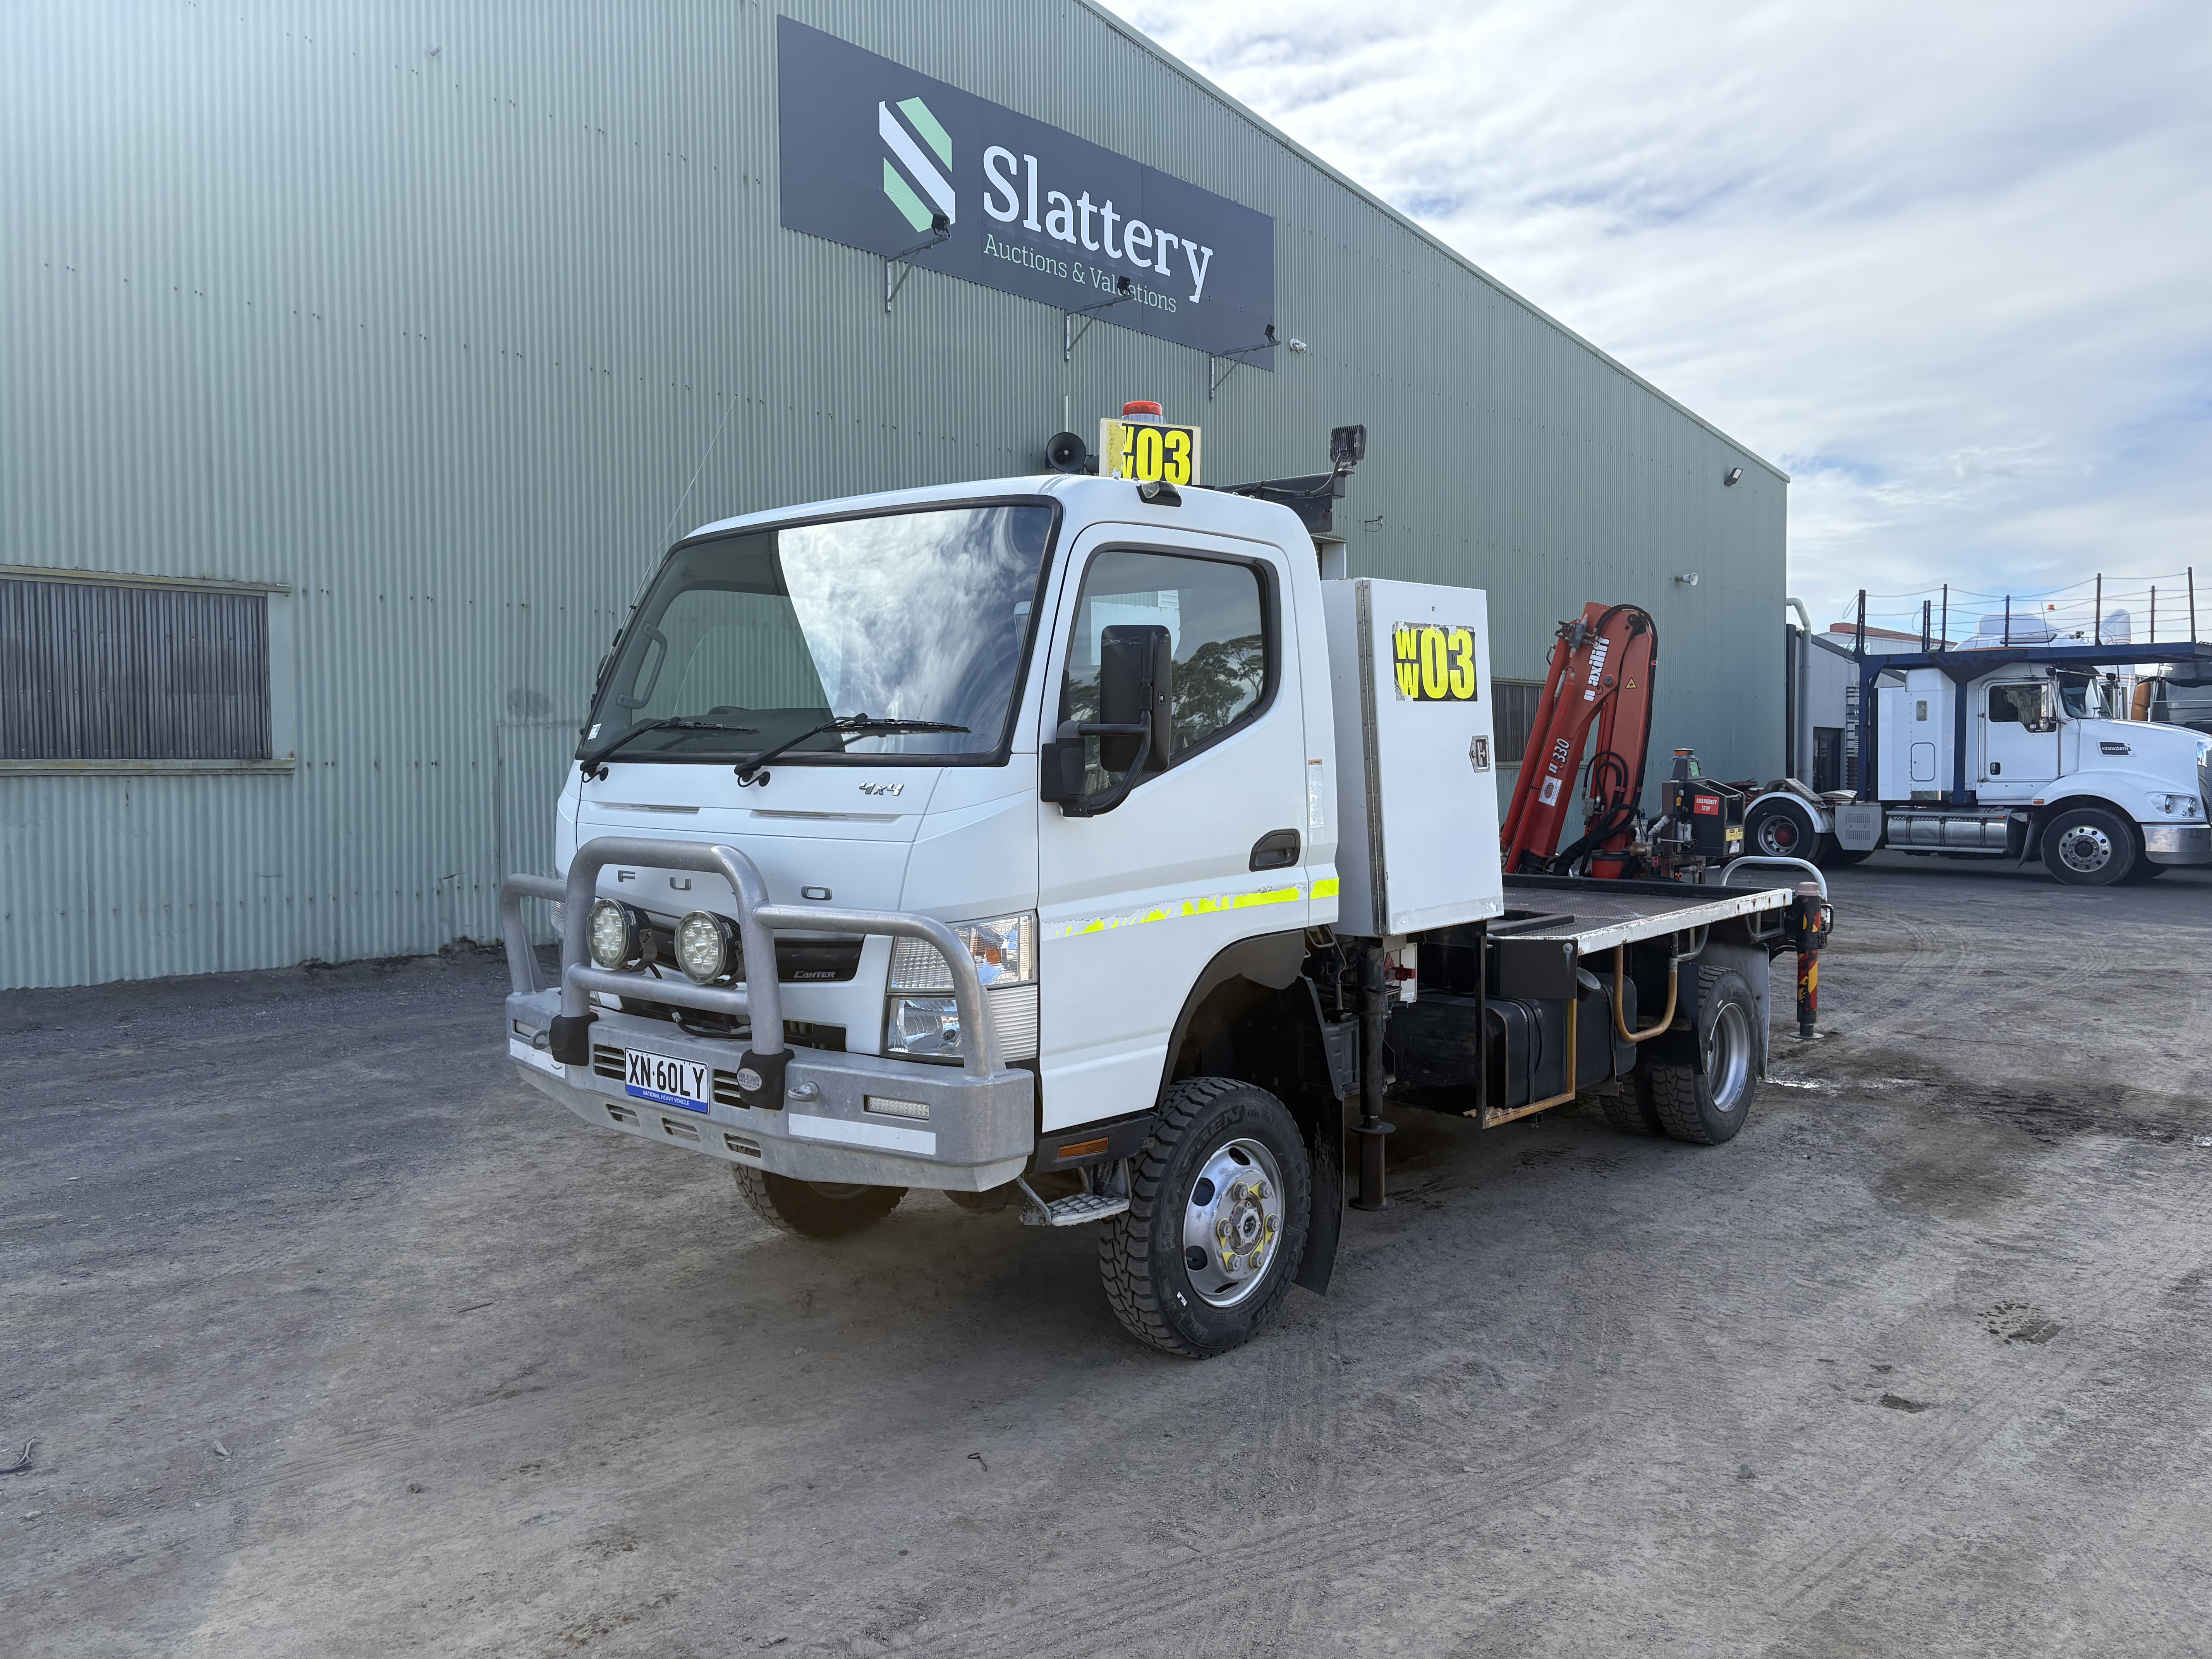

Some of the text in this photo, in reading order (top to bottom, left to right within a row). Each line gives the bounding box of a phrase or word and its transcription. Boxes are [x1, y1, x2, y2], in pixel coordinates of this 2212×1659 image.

[983, 146, 1213, 304] Slattery
[984, 234, 1067, 278] Auctions
[1072, 262, 1086, 285] &
[1420, 628, 1475, 699] 03
[617, 870, 832, 901] FUO
[643, 1090, 690, 1106] NATIONAL HEAVY VEHICLE
